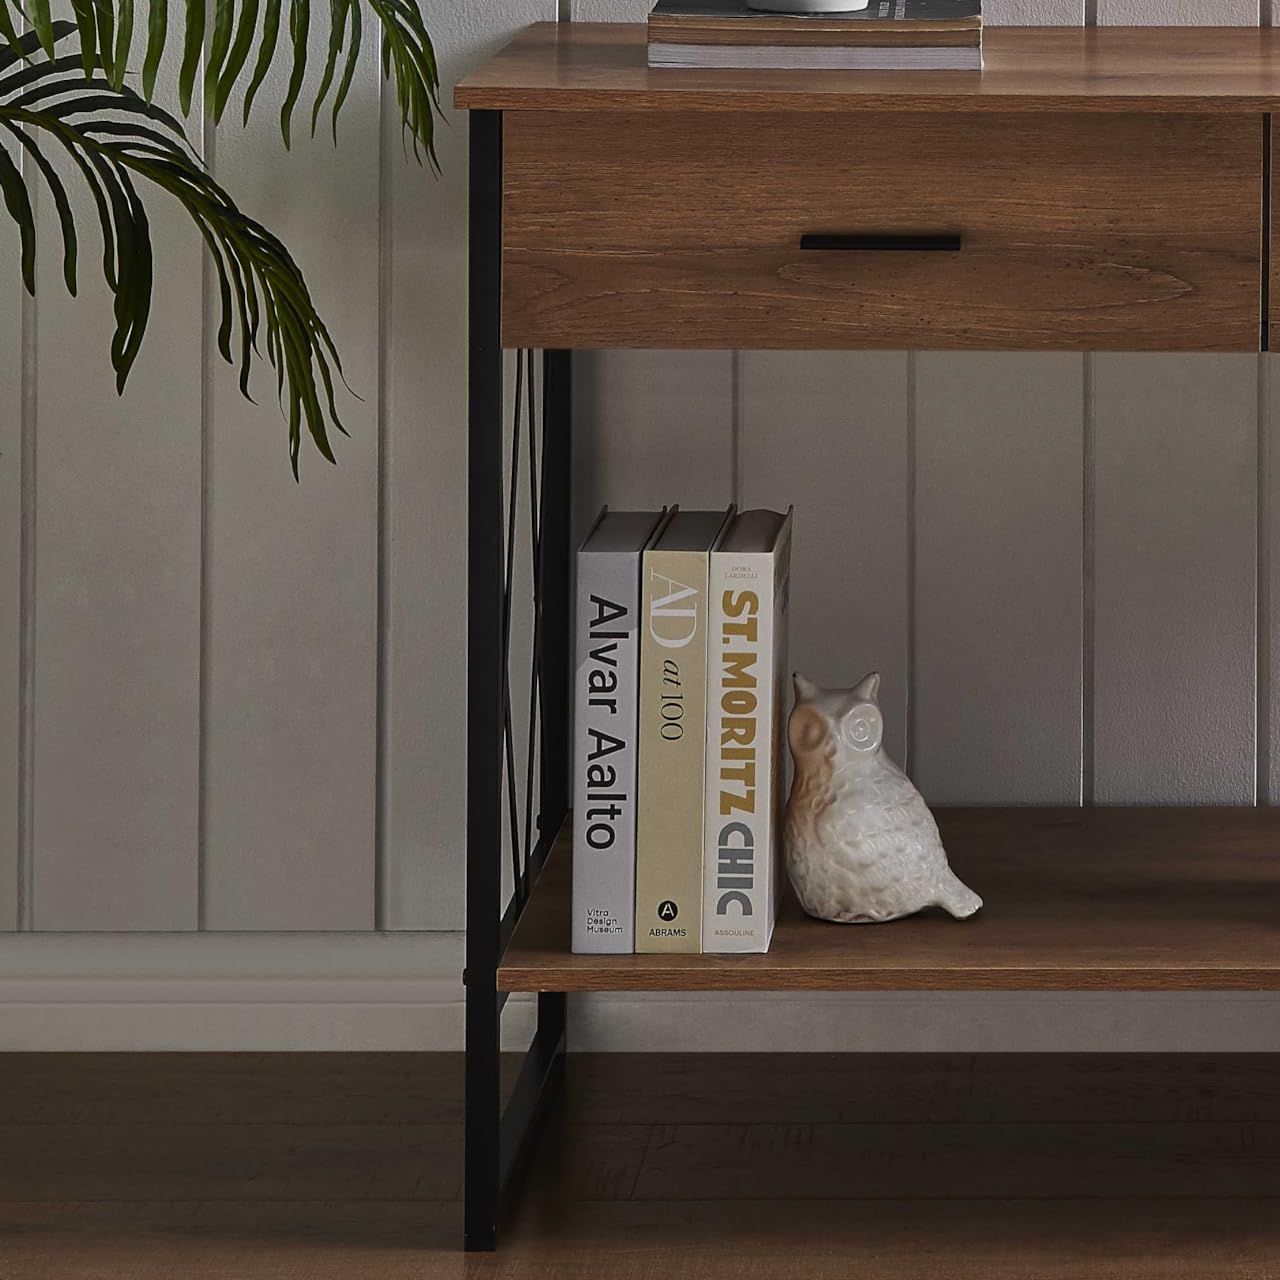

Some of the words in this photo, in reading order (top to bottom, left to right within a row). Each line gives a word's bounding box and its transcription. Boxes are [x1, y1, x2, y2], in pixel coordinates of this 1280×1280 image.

[650, 567, 699, 649] AD
[722, 590, 759, 645] ST.
[588, 594, 630, 715] Alvar
[662, 659, 683, 688] at
[660, 693, 684, 740] 100
[719, 652, 758, 816] MORITZ
[586, 726, 627, 850] Aalto
[716, 821, 754, 916] CHIC
[586, 926, 623, 934] Museum
[587, 909, 609, 917] Vitra
[587, 917, 617, 926] Design
[649, 928, 687, 937] ABRAMS
